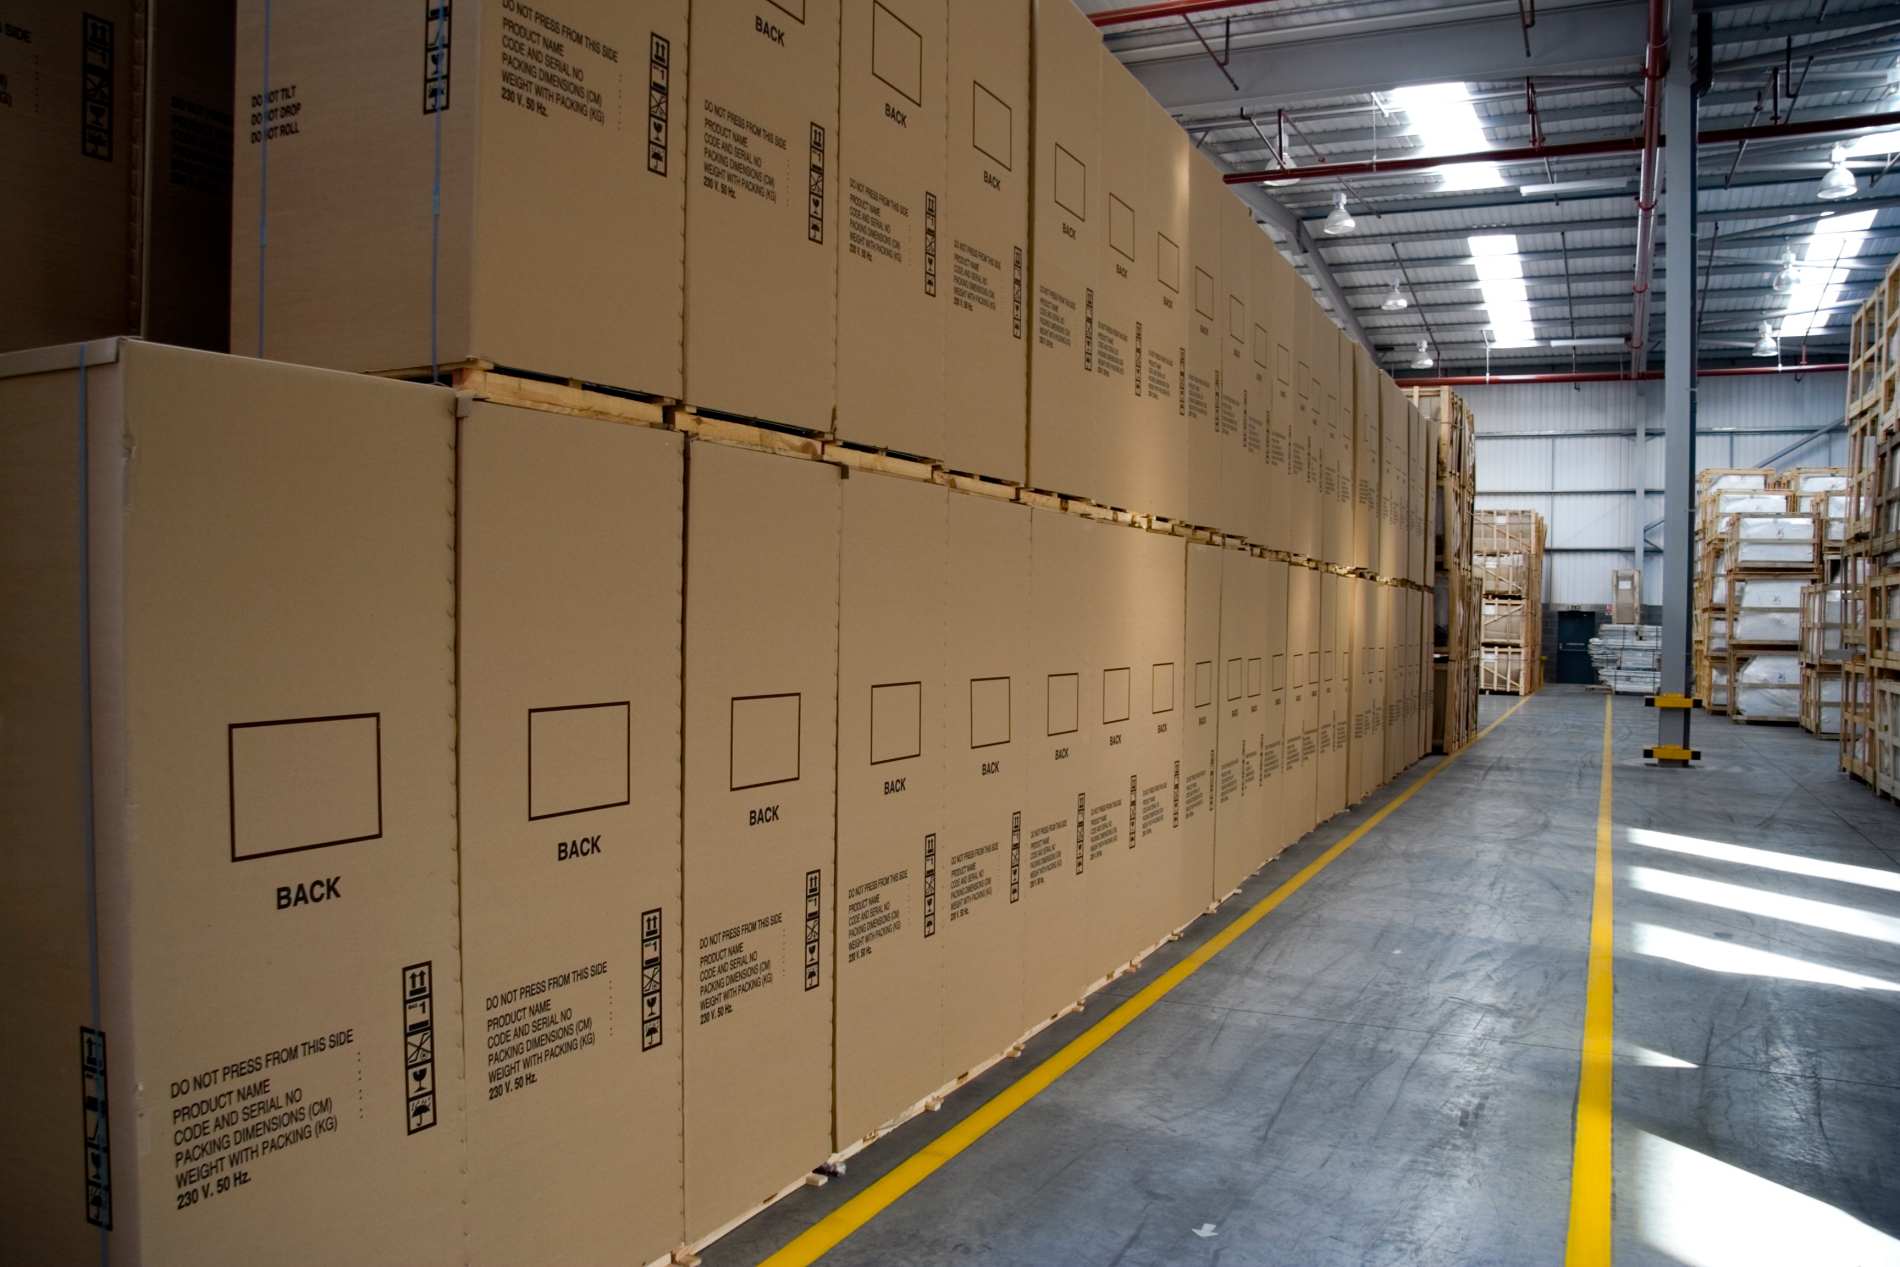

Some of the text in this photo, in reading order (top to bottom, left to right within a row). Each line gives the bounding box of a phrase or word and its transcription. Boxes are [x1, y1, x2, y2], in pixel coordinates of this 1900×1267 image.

[503, 16, 564, 57] PRODUCT NAME
[517, 1, 533, 22] NOT
[535, 10, 560, 35] PRESS
[562, 24, 583, 46] FROM
[585, 36, 600, 55] THIS
[602, 44, 618, 64] SIDE
[755, 15, 785, 47] BACK
[503, 33, 583, 83] CODE AND SERIAL NO
[503, 51, 537, 78] PACKING
[539, 68, 584, 99] DIMENSIONS
[251, 94, 262, 107] DO
[280, 85, 296, 101] TILT
[502, 69, 533, 94] WEIGHT
[535, 83, 554, 103] WITH
[556, 92, 588, 117] PACKING
[502, 86, 515, 104] 230
[526, 97, 535, 112] 50
[251, 112, 262, 126] DO
[280, 102, 301, 118] DROP
[885, 103, 907, 128] BACK
[251, 130, 261, 144] DO
[280, 121, 299, 137] ROLL
[984, 170, 1000, 191] BACK
[982, 761, 1000, 776] BACK
[884, 778, 906, 796] BACK
[749, 805, 779, 827] BACK
[558, 834, 602, 862] BACK
[277, 876, 340, 911] BACK
[486, 961, 607, 1011] DO NOT PRESS FROM THIS SIDE
[487, 999, 551, 1032] PRODUCT NAME
[488, 1008, 572, 1049] CODE AND SERIAL NO
[488, 1016, 592, 1066] PACKING DIMENSIONS (CM)
[489, 1031, 595, 1084] WEIGHT WITH PACKING (KG)
[170, 1028, 354, 1098] DO NOT PRESS FROM THIS SIDE
[172, 1078, 271, 1125] PRODUCT NAME
[489, 1084, 503, 1101] 230
[514, 1076, 524, 1090] 50
[174, 1087, 302, 1146] CODE AND SERIAL NO
[175, 1096, 332, 1168] PACKING DIMENSIONS (CM)
[176, 1114, 338, 1189] WEIGHT WITH PACKING (KG)
[176, 1188, 199, 1211] 230
[216, 1175, 231, 1194] 50
